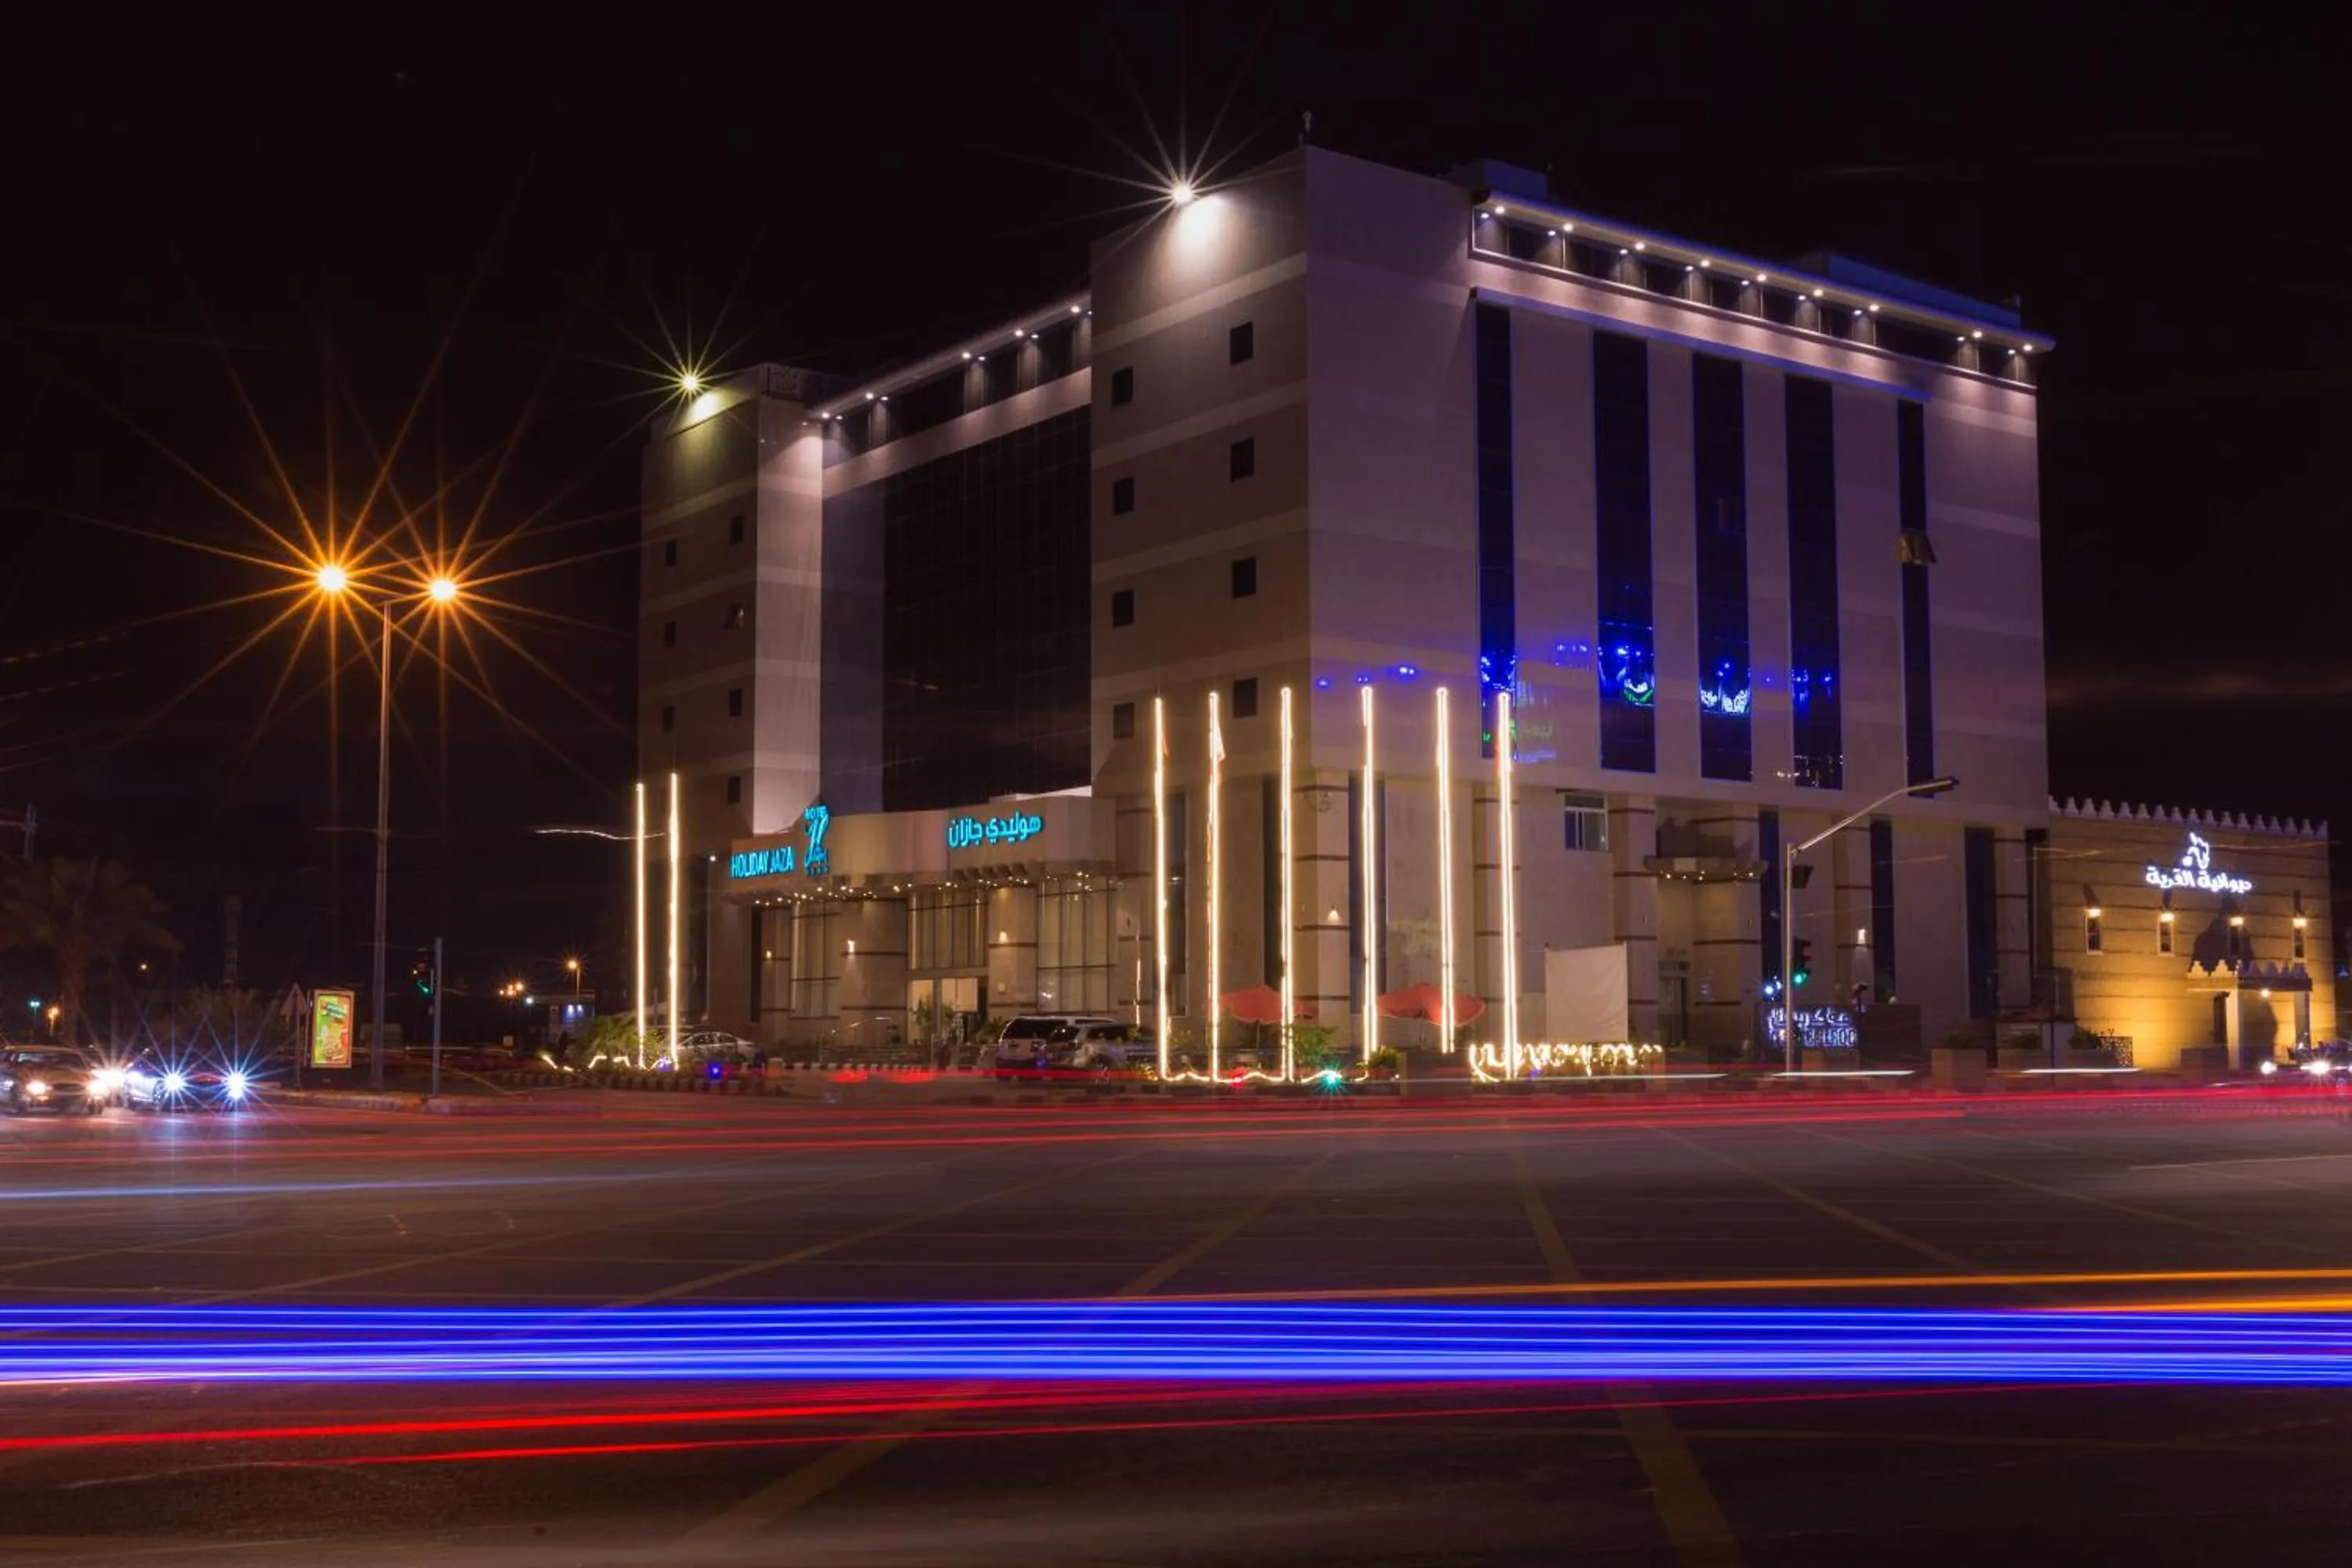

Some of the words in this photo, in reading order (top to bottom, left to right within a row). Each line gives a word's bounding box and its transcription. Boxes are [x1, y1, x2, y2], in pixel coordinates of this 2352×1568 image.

[948, 817, 982, 848] جازان
[986, 811, 1042, 844] هوليدي
[731, 849, 769, 878] HOLIDAY
[2145, 866, 2197, 888] القرية
[2198, 869, 2252, 894] ديوانية
